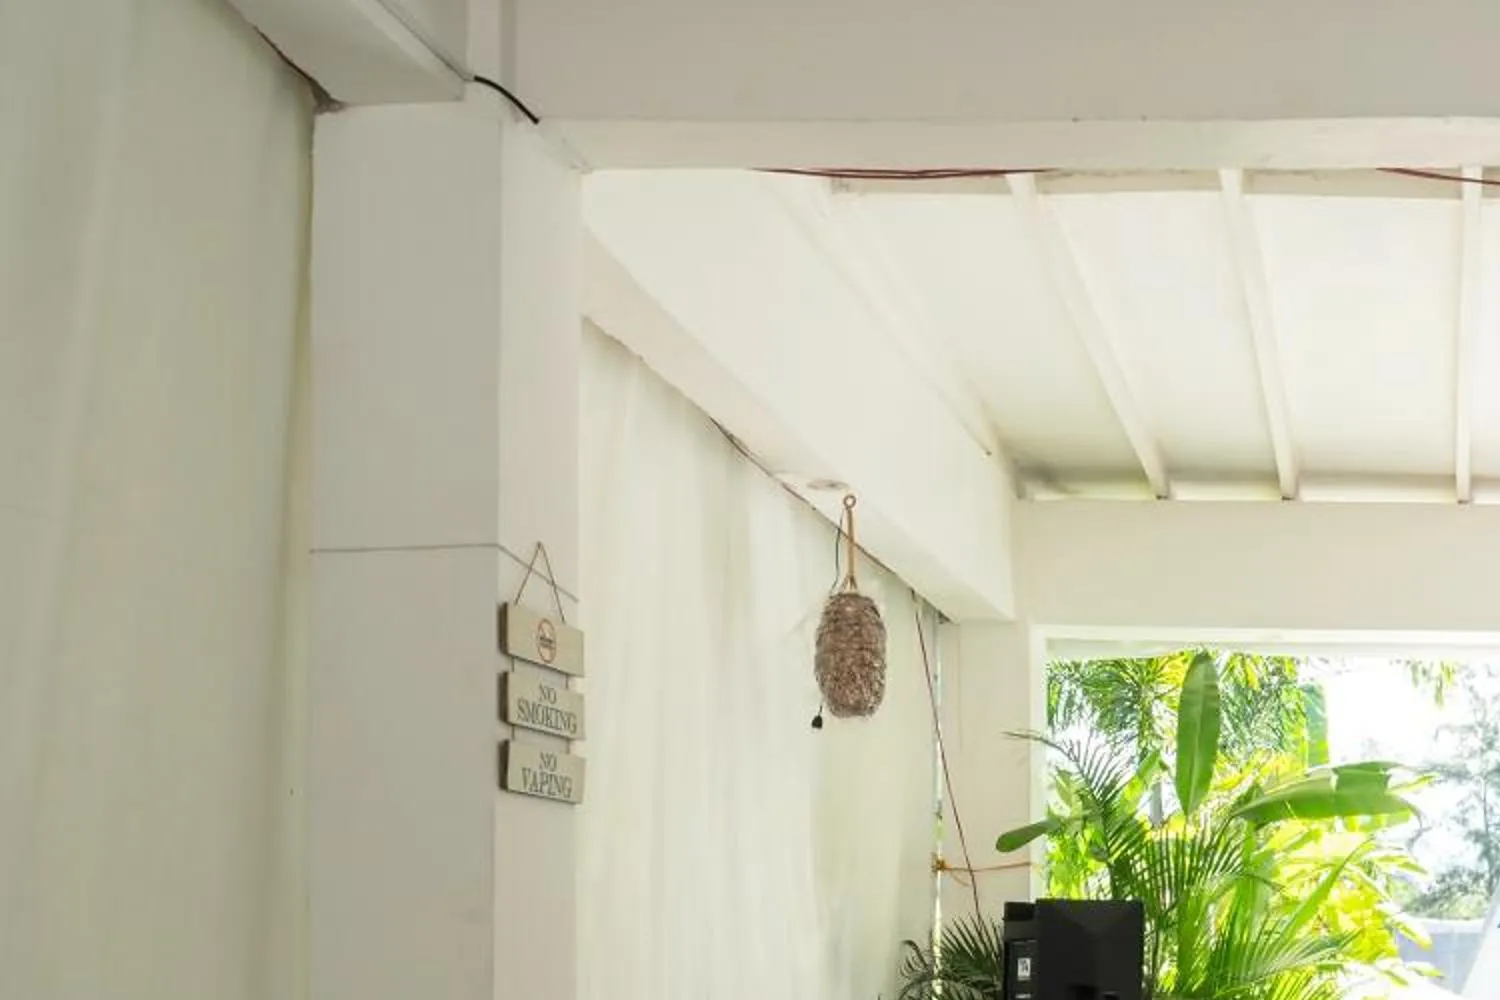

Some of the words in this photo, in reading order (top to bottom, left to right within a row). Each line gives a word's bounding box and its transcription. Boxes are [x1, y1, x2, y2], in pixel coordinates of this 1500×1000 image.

[539, 683, 557, 705] NO
[517, 698, 577, 734] SMOKING
[540, 752, 558, 773] NO
[522, 767, 572, 798] VAPING
